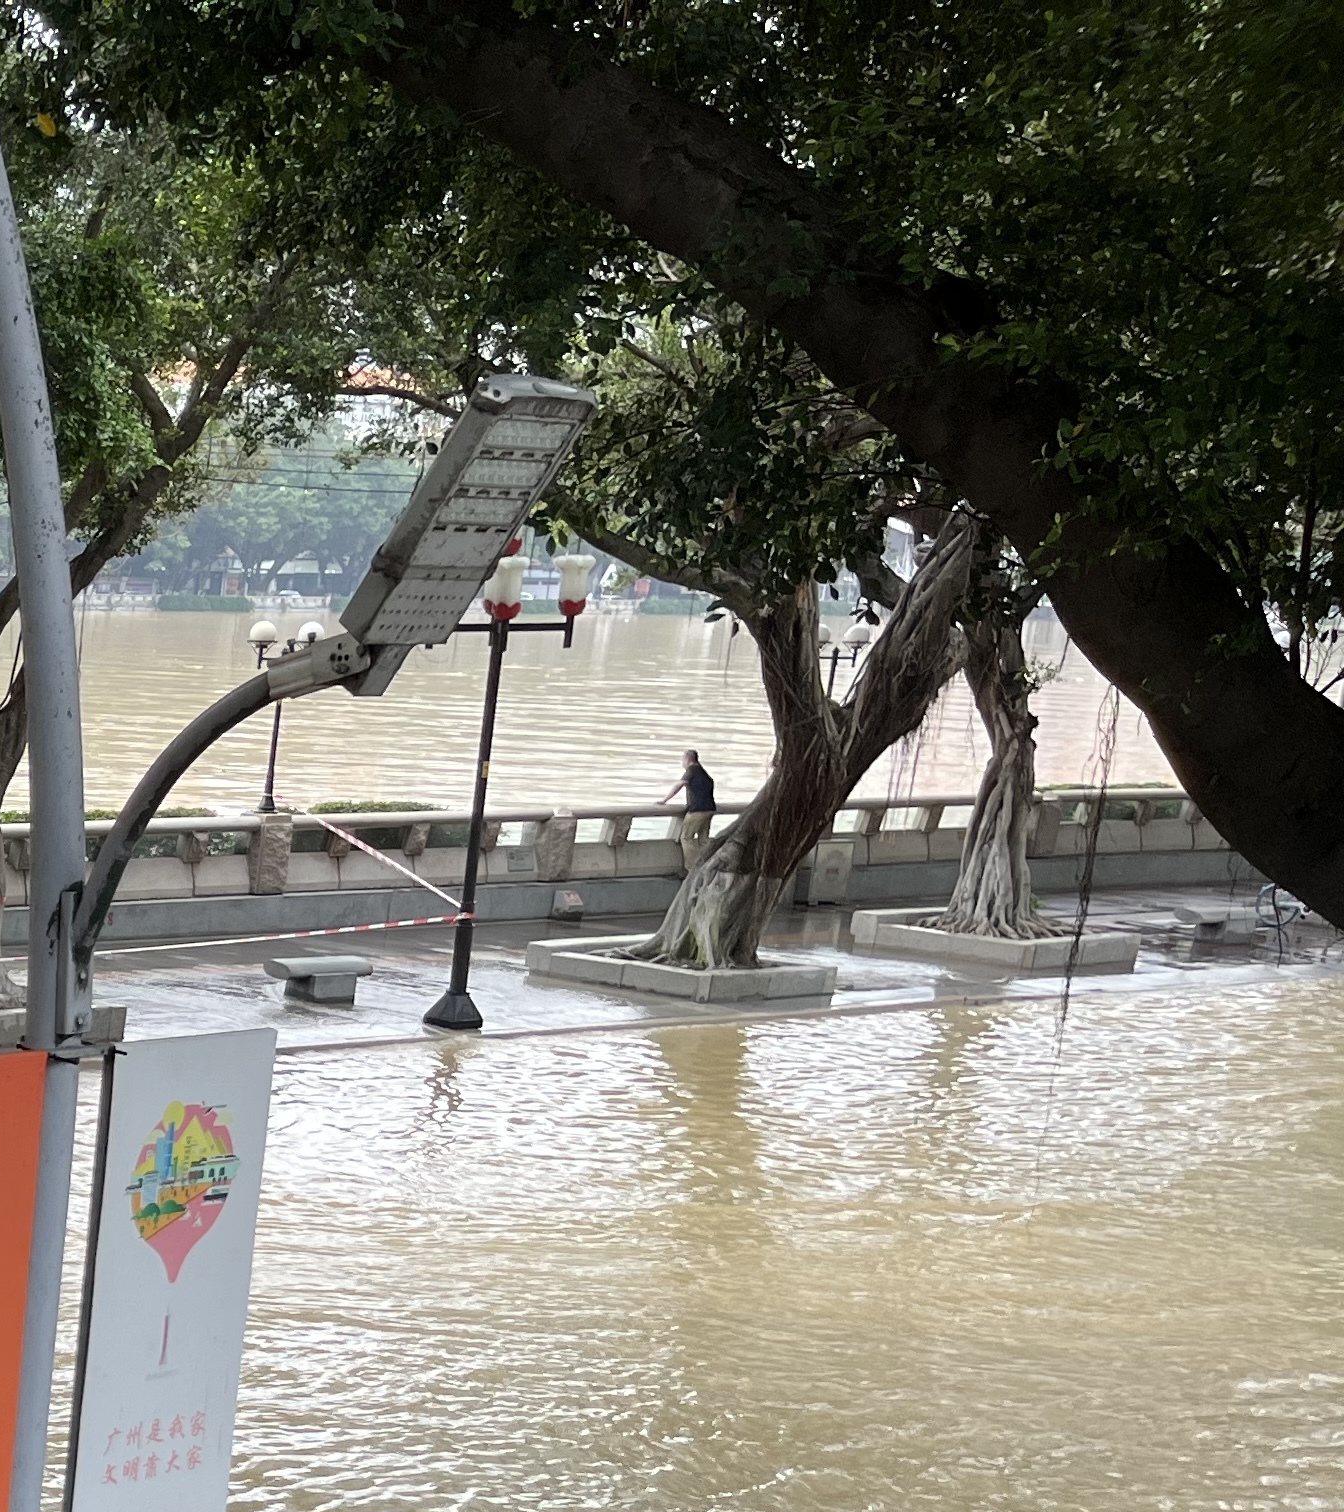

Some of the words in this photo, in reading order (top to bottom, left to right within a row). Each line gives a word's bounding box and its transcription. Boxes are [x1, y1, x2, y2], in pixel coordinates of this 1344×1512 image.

[103, 1410, 206, 1456] 广州是我家
